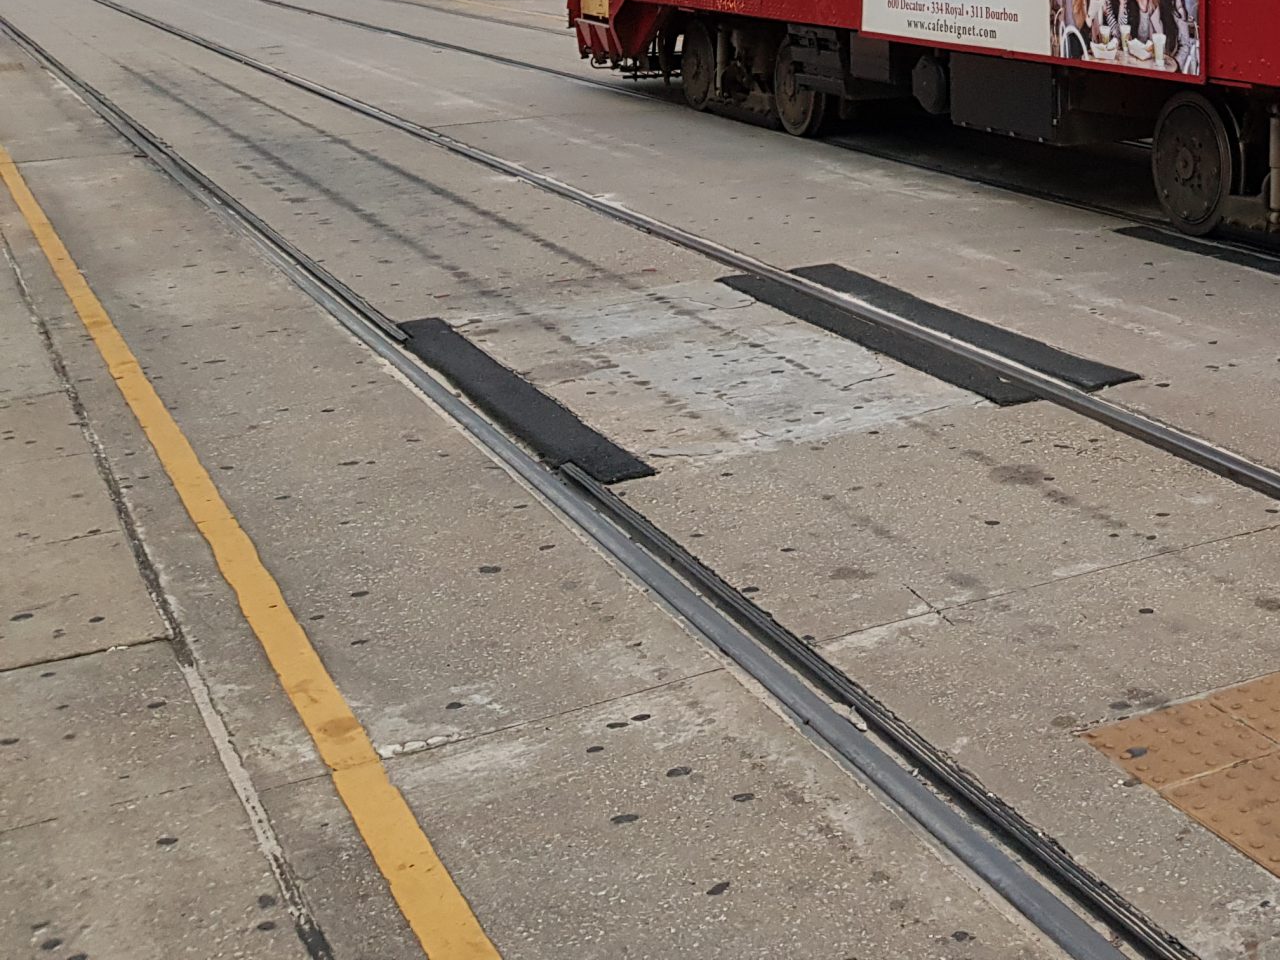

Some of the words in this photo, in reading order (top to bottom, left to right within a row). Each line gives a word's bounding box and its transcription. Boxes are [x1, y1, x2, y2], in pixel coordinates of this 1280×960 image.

[930, 1, 943, 15] 334
[945, 2, 964, 20] Royal
[970, 5, 983, 19] 311
[985, 6, 1019, 23] Bourbon
[906, 19, 998, 39] www.cafebeignet.com
